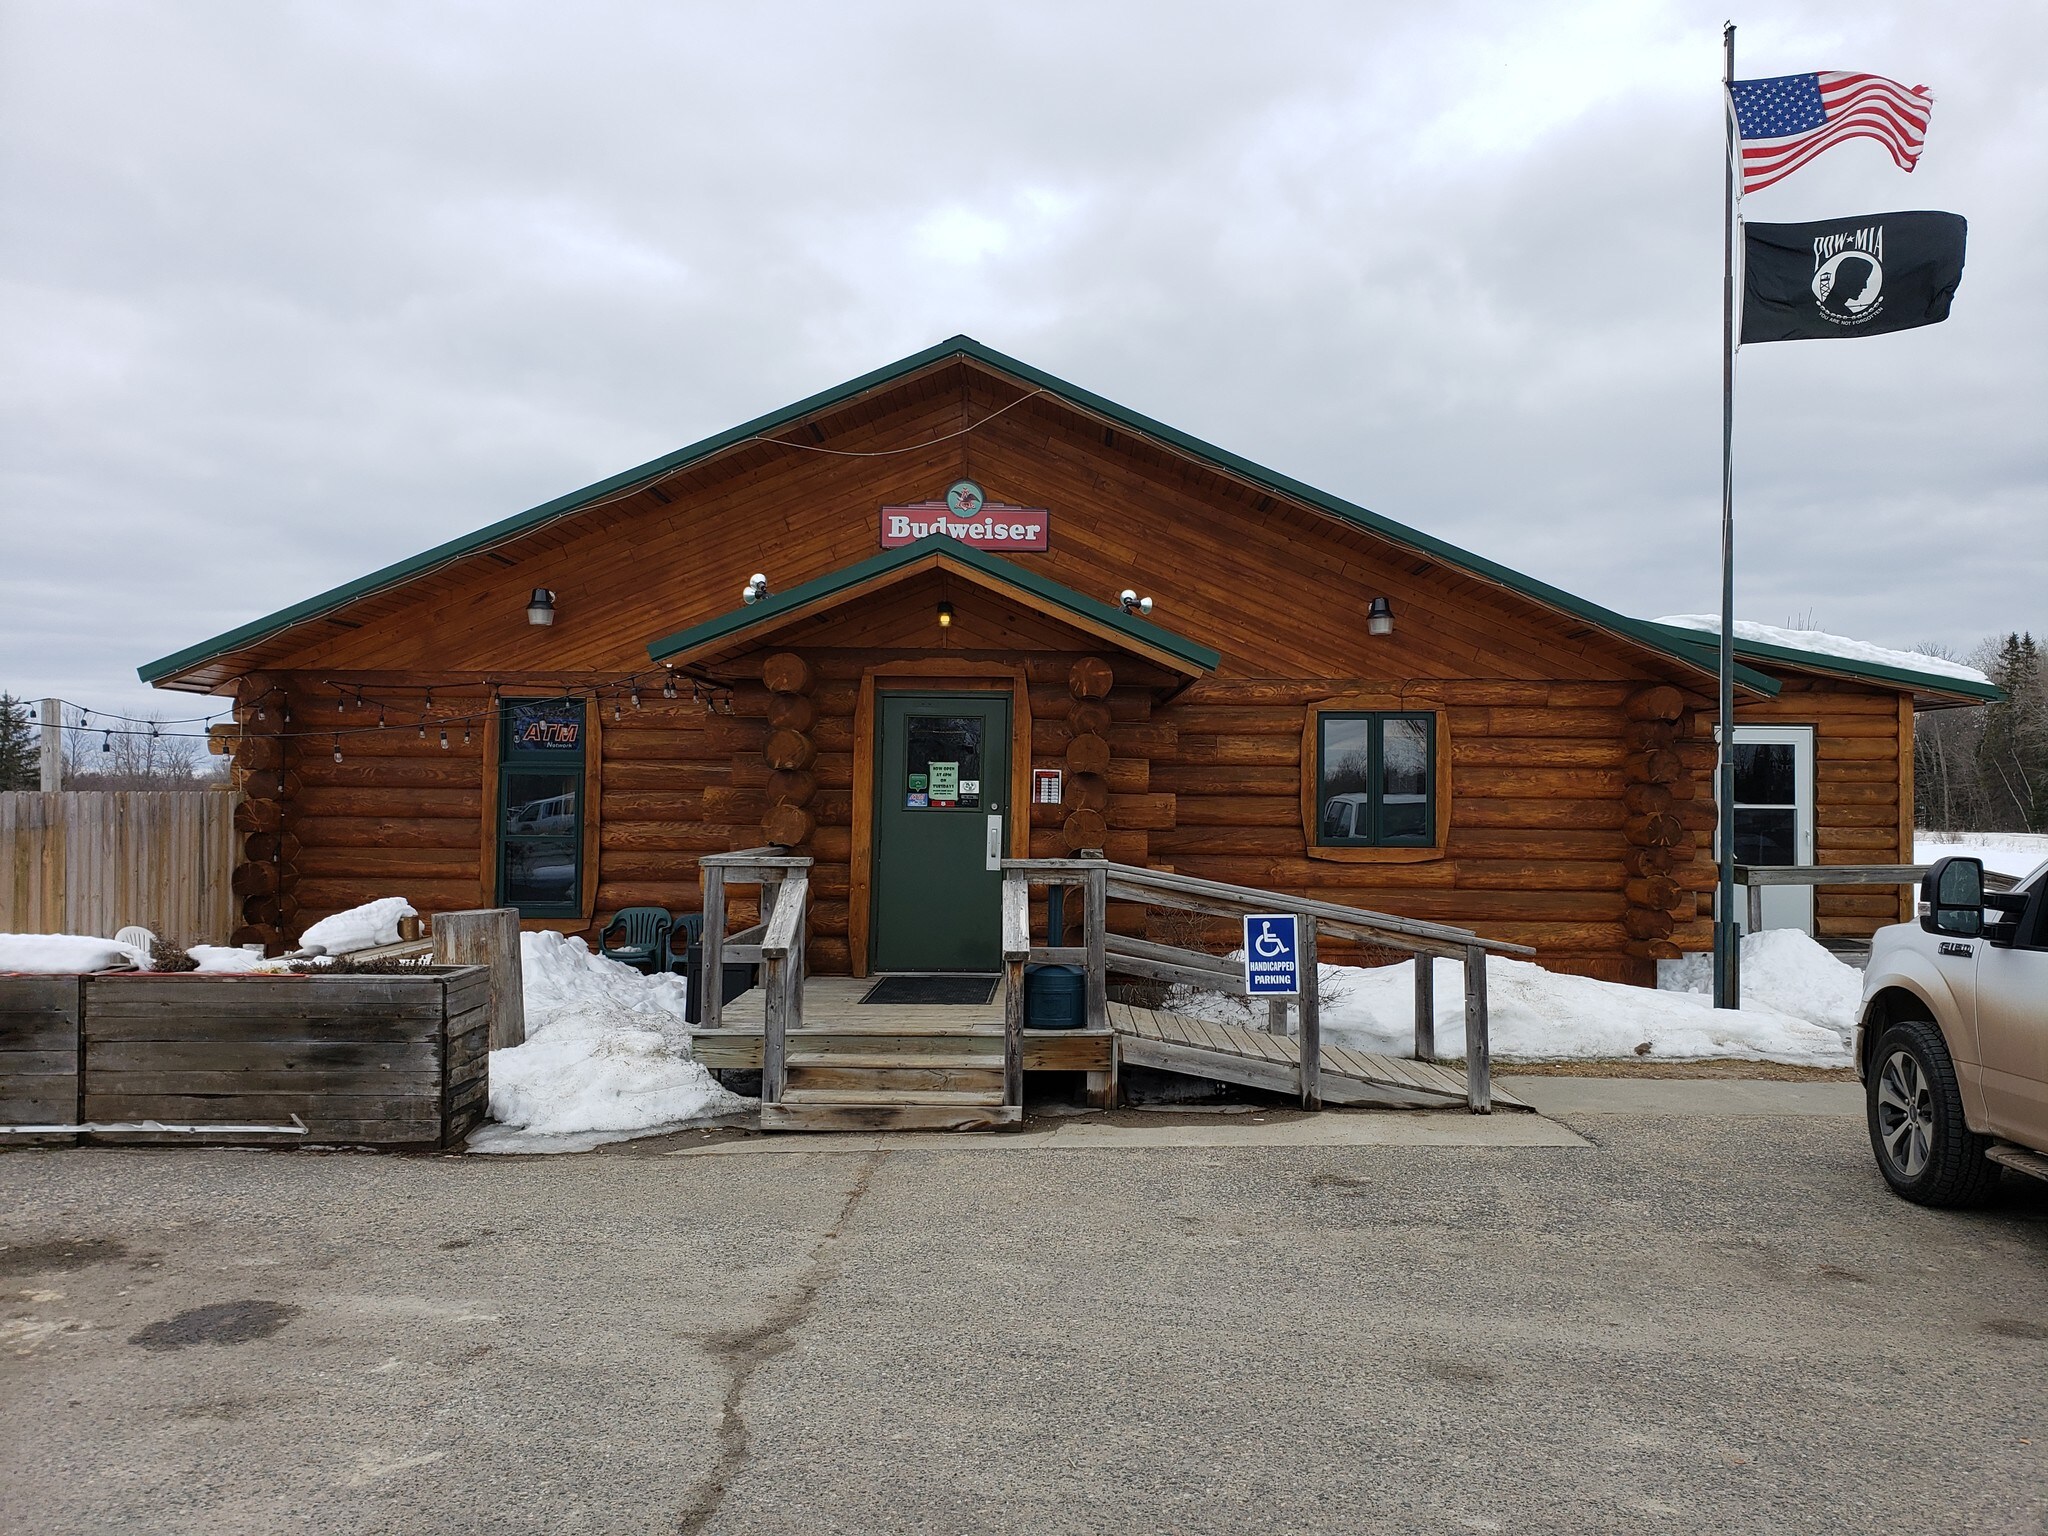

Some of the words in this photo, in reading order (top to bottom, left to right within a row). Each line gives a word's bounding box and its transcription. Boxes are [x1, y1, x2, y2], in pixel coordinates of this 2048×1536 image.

[1814, 232, 1848, 273] POW
[1854, 225, 1883, 263] MIA
[1819, 311, 1829, 320] YOU
[1852, 307, 1884, 326] FORGOTTEN
[887, 515, 1041, 541] Budweiser
[522, 723, 579, 742] ATM
[1250, 961, 1295, 972] HANDICAPPED
[1254, 975, 1291, 985] PARKING
